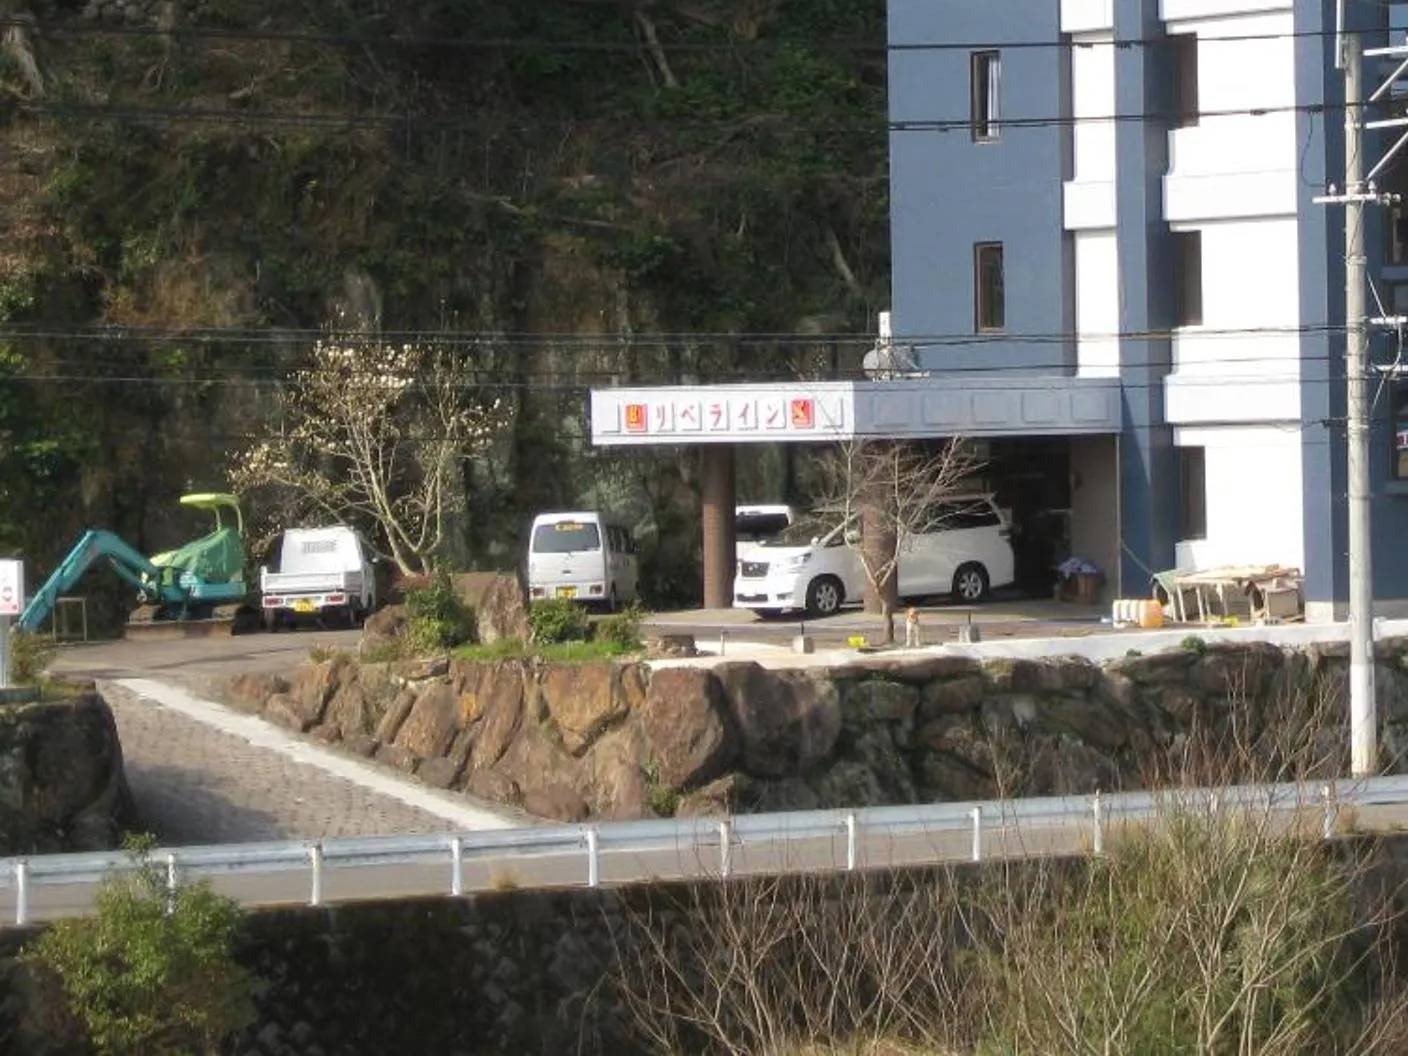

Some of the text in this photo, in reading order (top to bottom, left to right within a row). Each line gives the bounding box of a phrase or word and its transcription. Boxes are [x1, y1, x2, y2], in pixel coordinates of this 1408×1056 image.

[656, 403, 779, 428] リベライン
